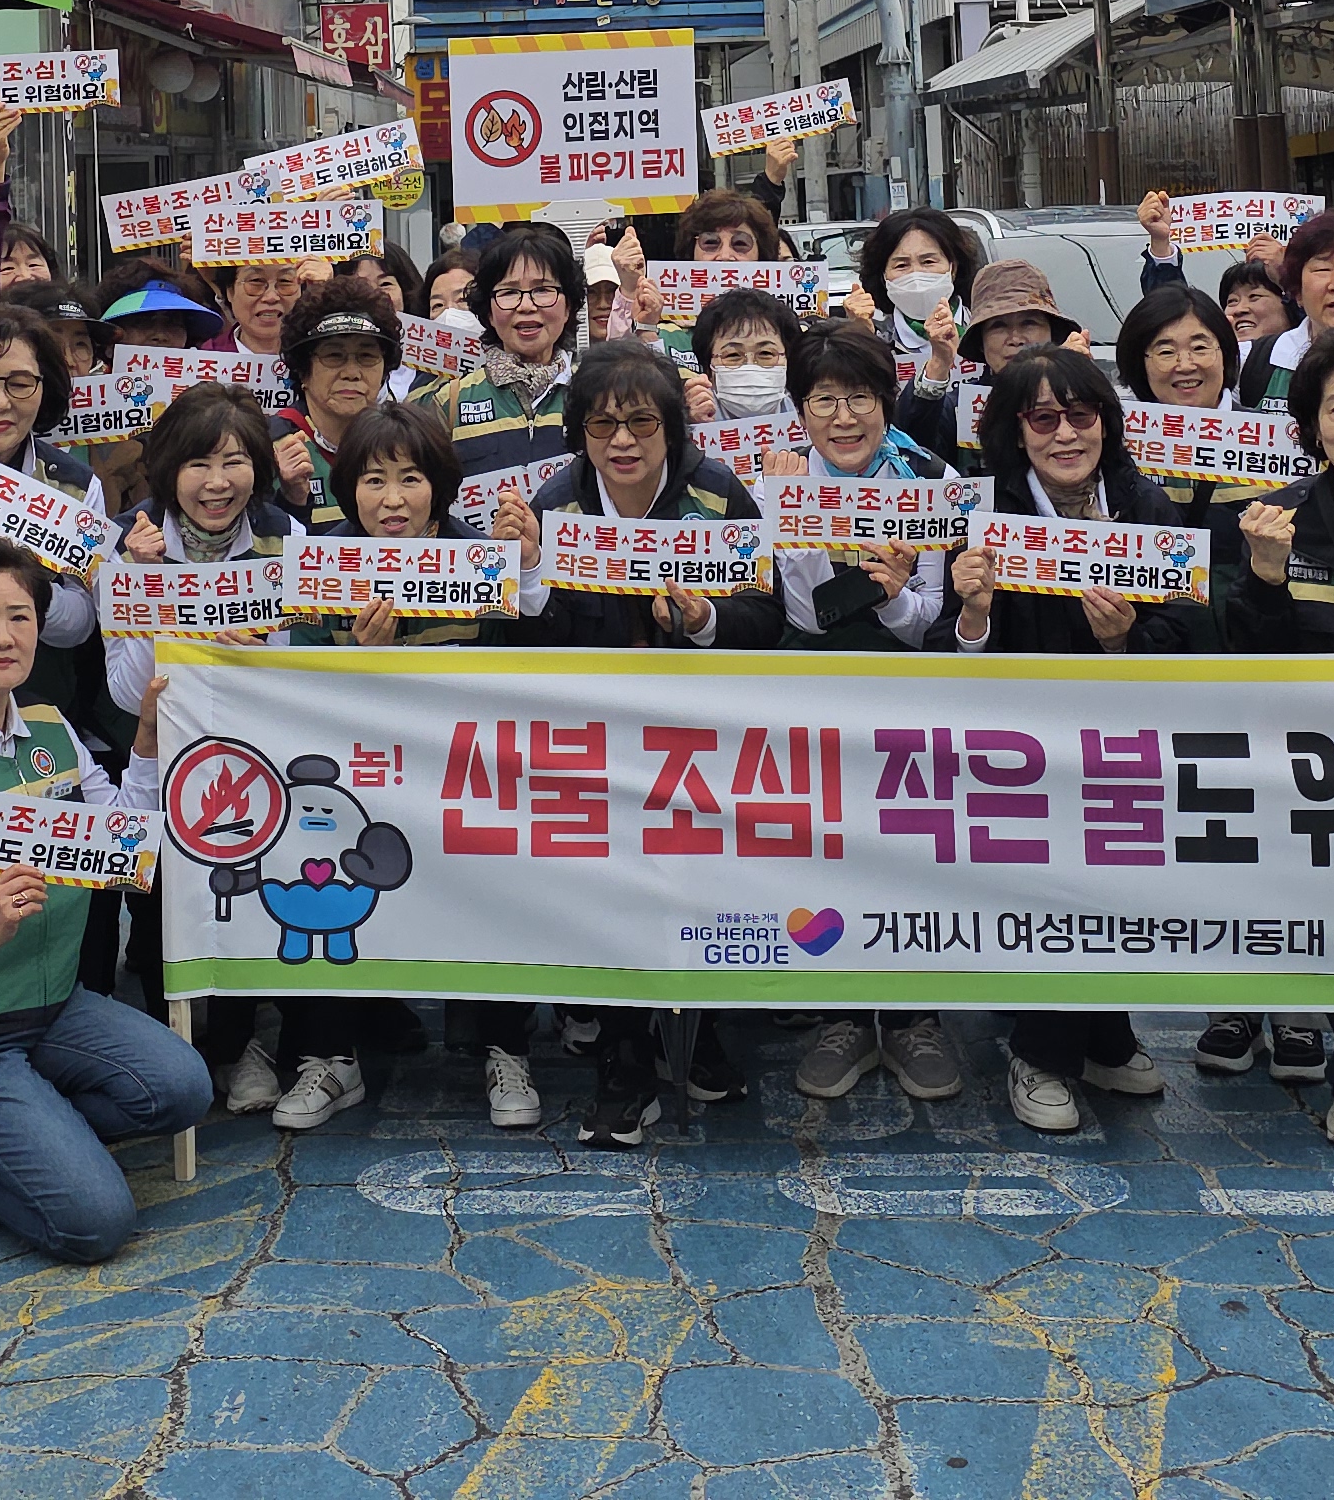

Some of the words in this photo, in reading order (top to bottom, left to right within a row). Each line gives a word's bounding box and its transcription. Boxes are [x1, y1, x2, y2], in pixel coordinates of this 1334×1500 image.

[324, 16, 389, 69] 홍삼
[24, 81, 107, 104] 위험해요!
[561, 68, 659, 103] 산림·산림
[562, 108, 661, 143] 인접지역
[716, 126, 747, 147] 작은
[750, 120, 779, 140] 불도
[782, 105, 846, 135] 위험해요!
[539, 153, 562, 185] 불
[568, 150, 635, 183] 피우기
[640, 147, 685, 180] 금지
[203, 236, 241, 257] 작은
[246, 234, 285, 255] 불도
[289, 231, 370, 254] 위험해요!
[3, 511, 95, 574] 위험해요!
[555, 552, 599, 577] 작은
[605, 557, 652, 583] 불도
[297, 577, 344, 602] 작은
[349, 578, 395, 602] 불도
[401, 580, 503, 607] 위험해요!
[440, 720, 610, 858] 산불
[641, 726, 845, 859] 조심!
[874, 727, 1050, 865] 작은
[1080, 728, 1259, 867] 불도
[28, 844, 139, 879] 위험해요!
[680, 926, 714, 942] BIG
[715, 926, 781, 942] HEART
[862, 910, 981, 954] 거제시
[996, 912, 1325, 958] 여성민방위기동대
[704, 943, 790, 965] GEOJE
